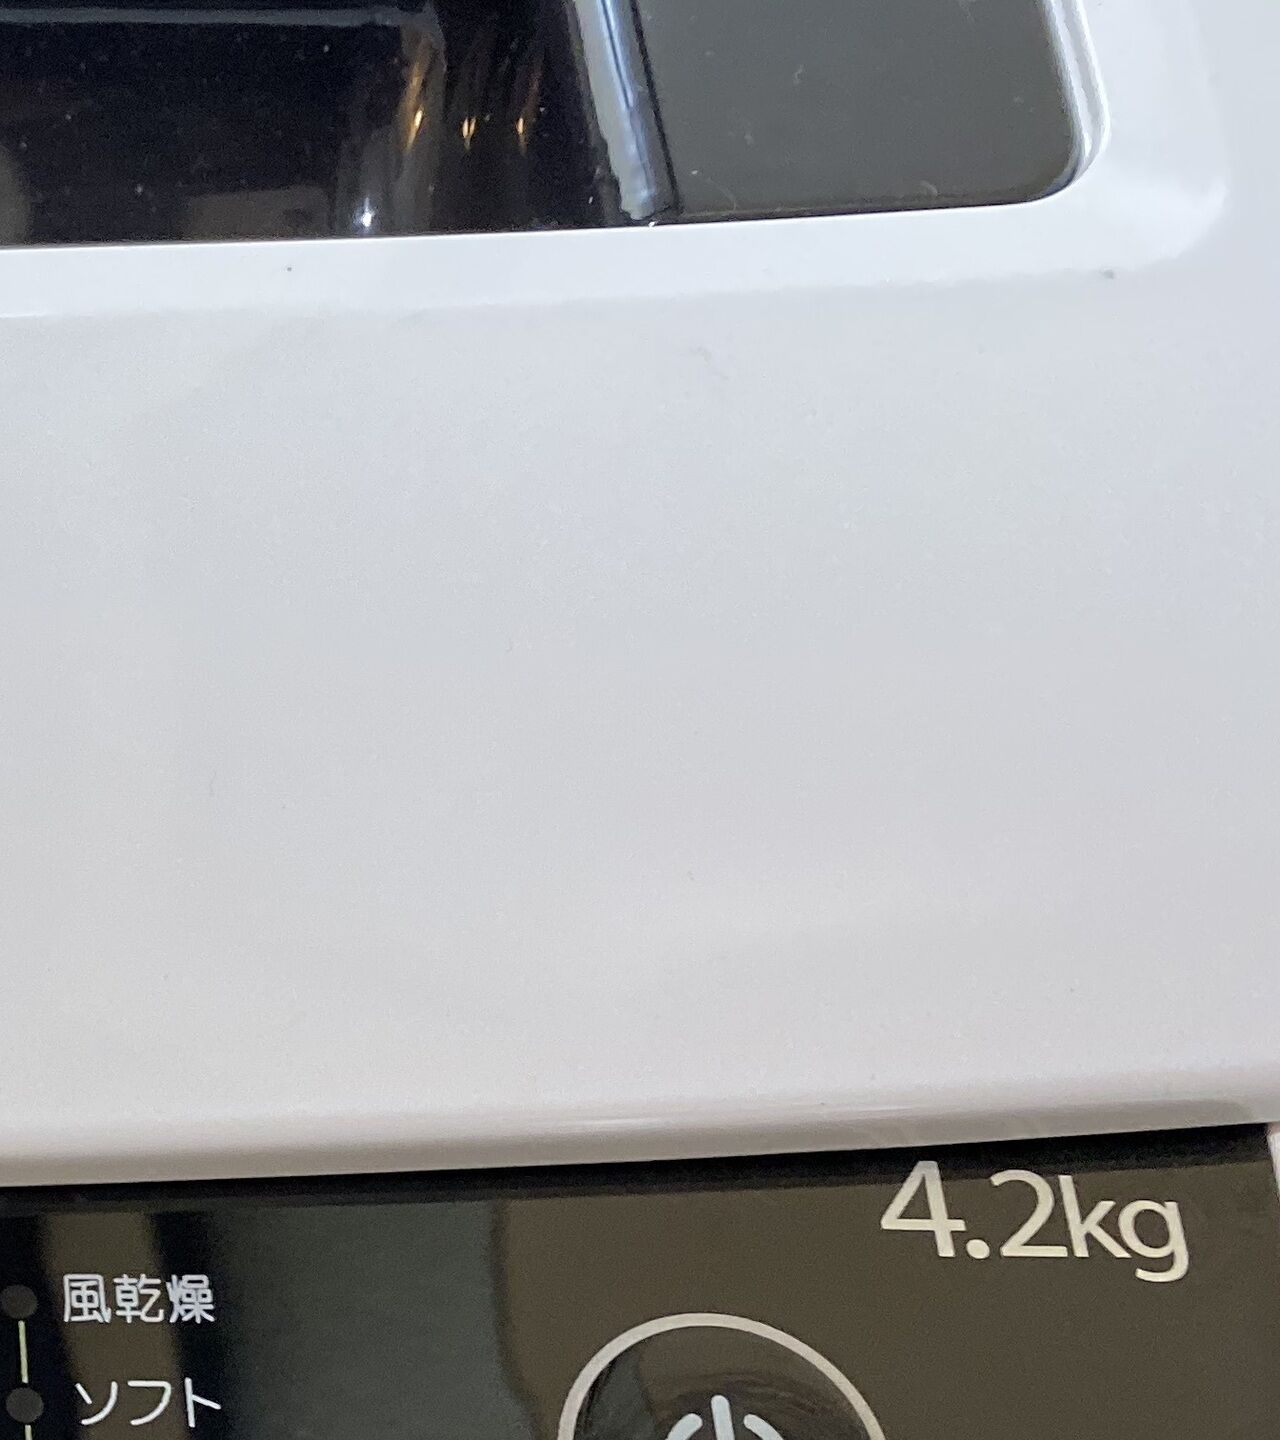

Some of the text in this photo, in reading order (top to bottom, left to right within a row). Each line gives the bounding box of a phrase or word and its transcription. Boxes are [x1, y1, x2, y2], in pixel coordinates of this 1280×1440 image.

[879, 1160, 1190, 1284] 4.2kg
[62, 1272, 216, 1325] 風乾燥
[74, 1376, 222, 1429] ソフト
